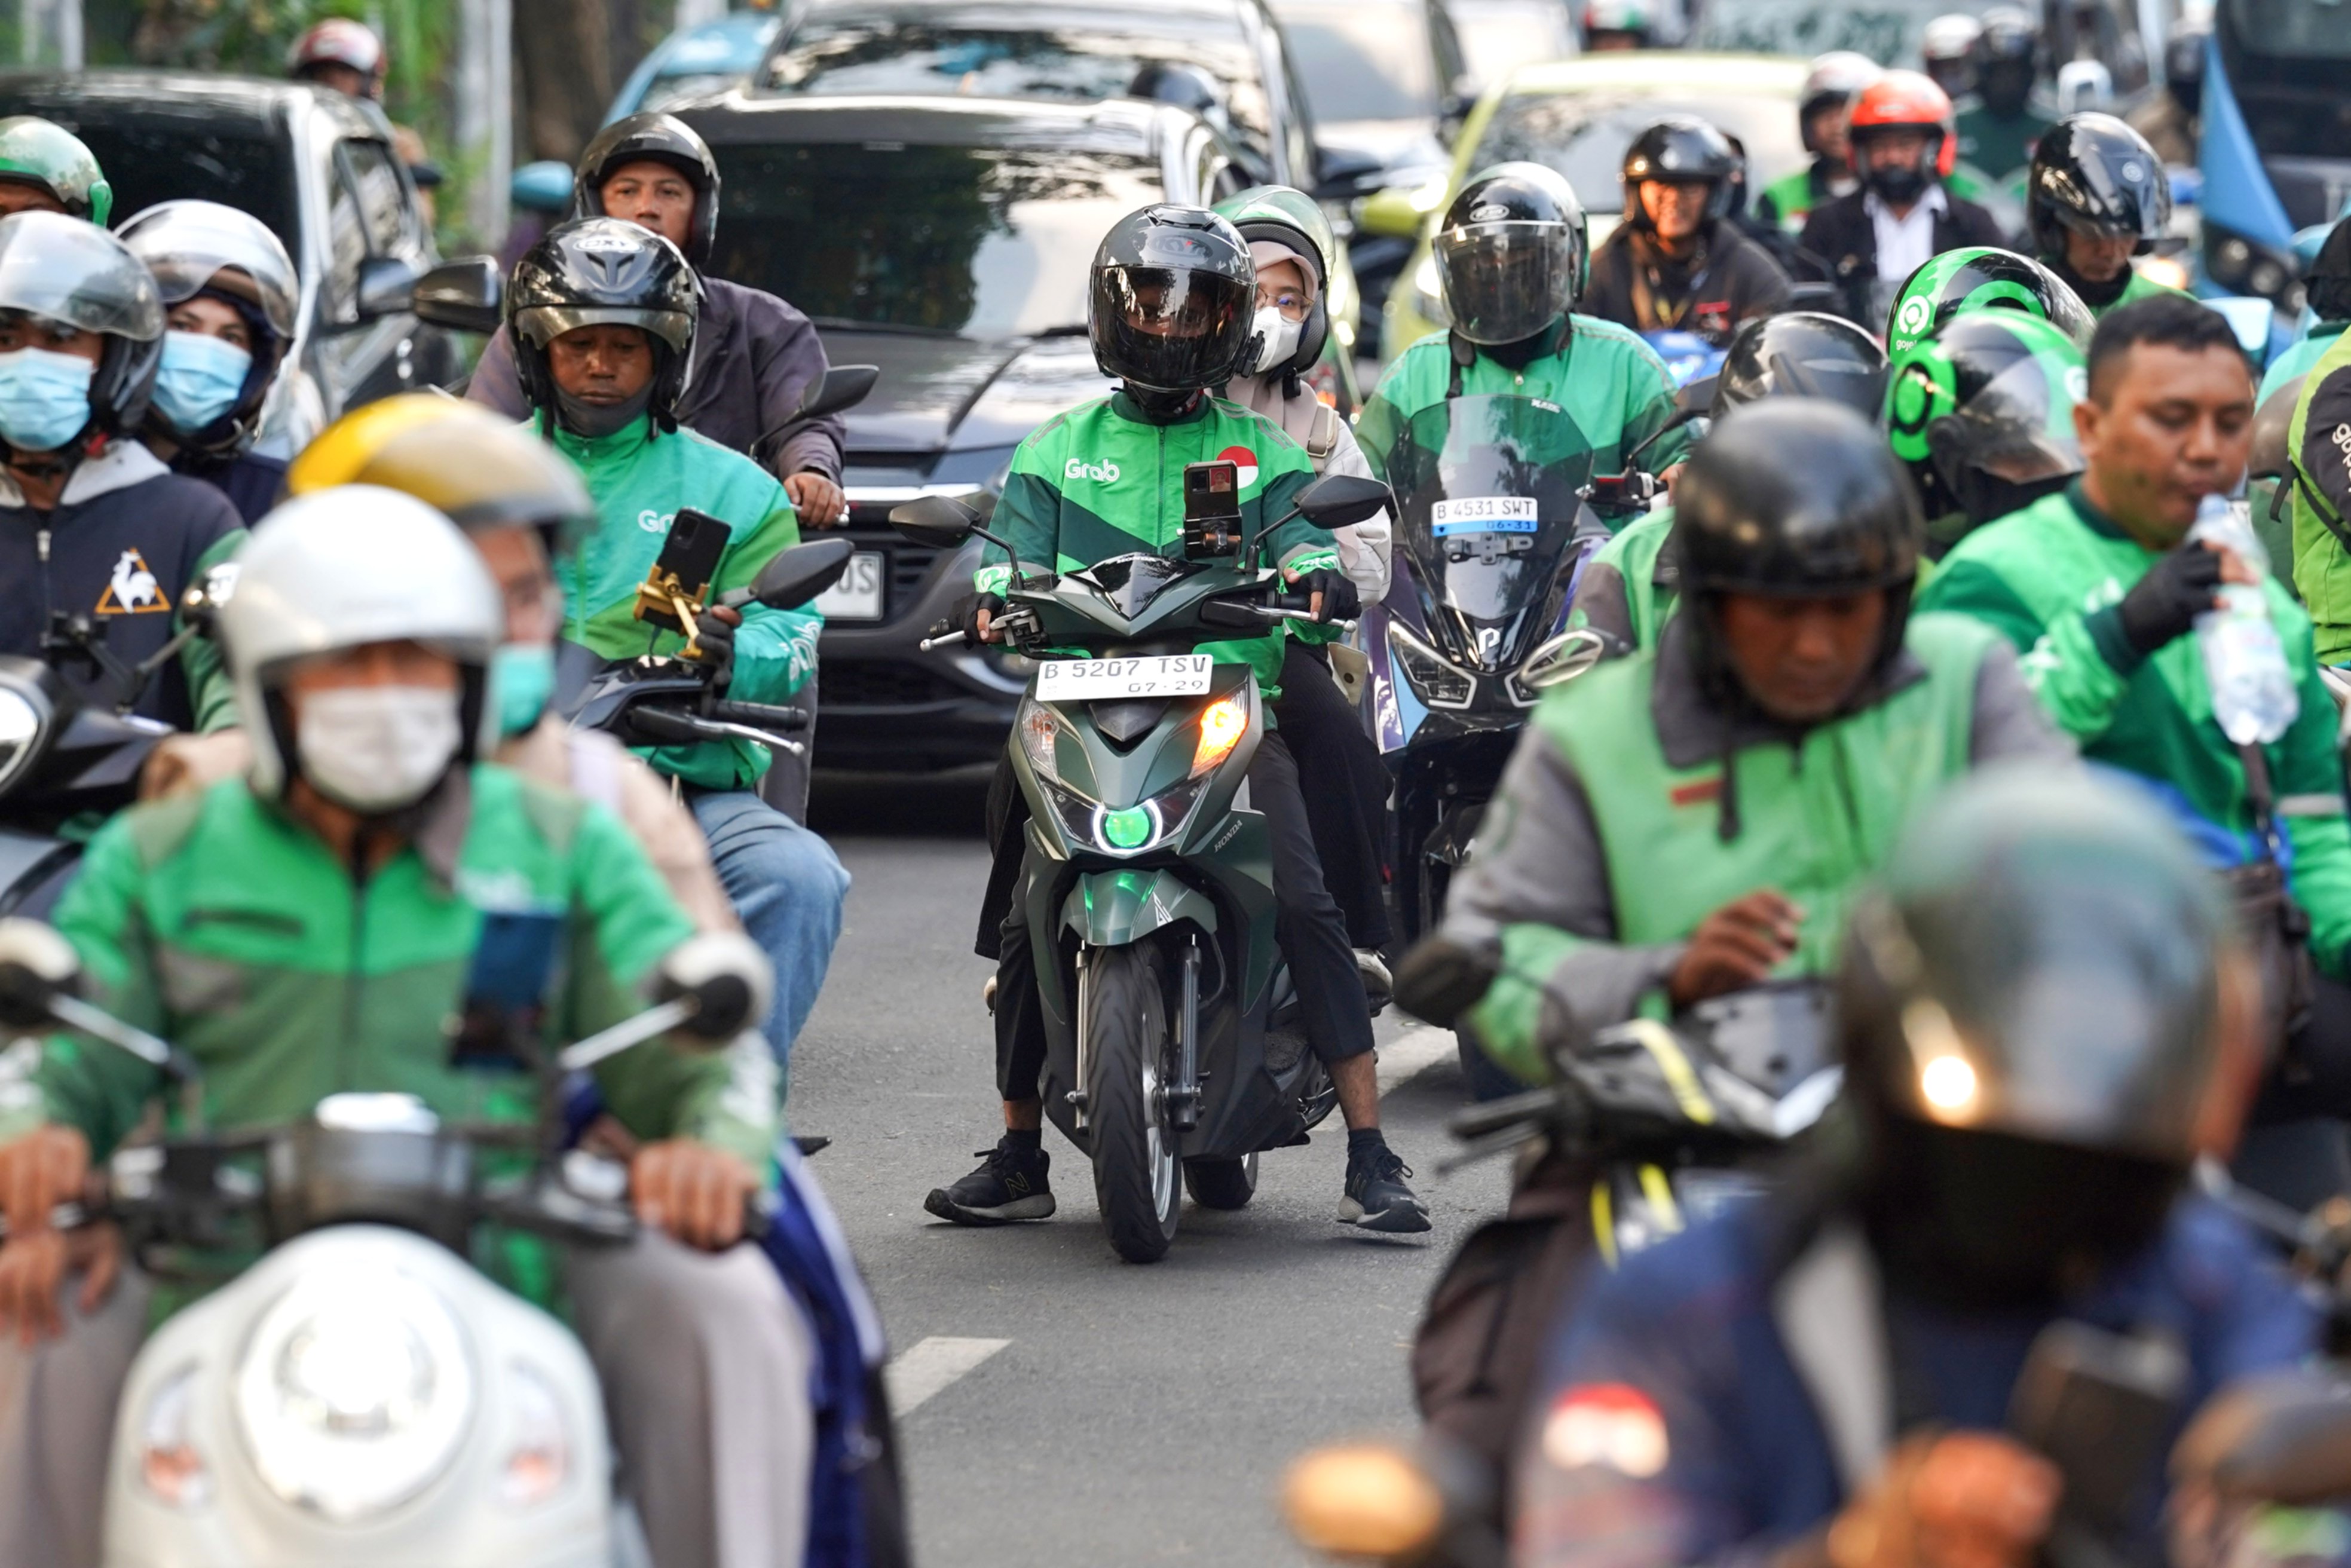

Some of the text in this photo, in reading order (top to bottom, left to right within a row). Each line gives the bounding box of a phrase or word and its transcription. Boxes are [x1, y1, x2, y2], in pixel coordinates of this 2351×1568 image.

[1896, 339, 1918, 351] goje
[1065, 458, 1119, 482] Grab
[1437, 500, 1532, 519] B 4531 SWT
[1045, 657, 1206, 679] B 5207 TSV
[1214, 819, 1242, 853] HONDA
